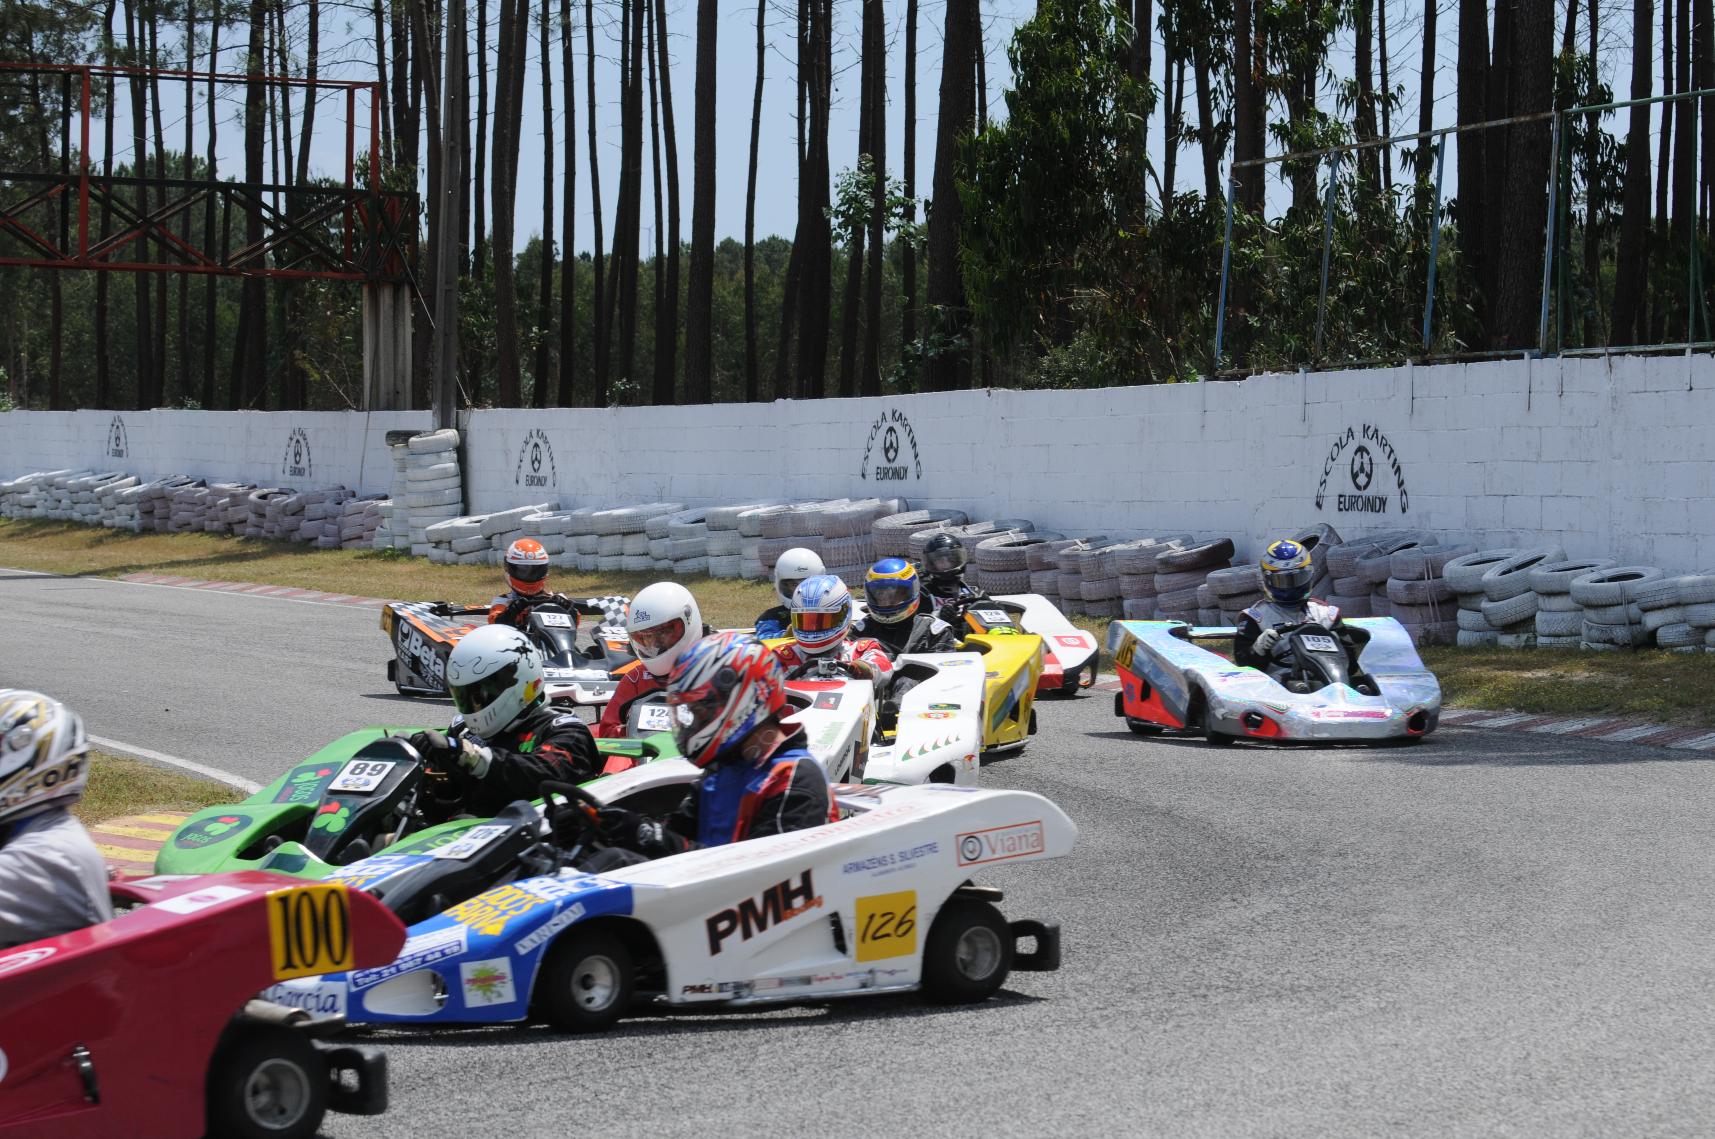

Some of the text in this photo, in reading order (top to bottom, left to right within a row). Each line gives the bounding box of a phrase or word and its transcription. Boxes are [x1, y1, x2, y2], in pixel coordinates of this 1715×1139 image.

[876, 466, 908, 481] EUROINDY
[1315, 424, 1409, 514] ESCOLA KARTING
[1337, 494, 1388, 513] EUROINDY
[408, 629, 445, 681] Beta
[349, 762, 388, 777] 89
[983, 830, 1040, 855] Viana
[277, 888, 350, 970] 100
[705, 867, 814, 957] PMH
[861, 904, 916, 944] 126
